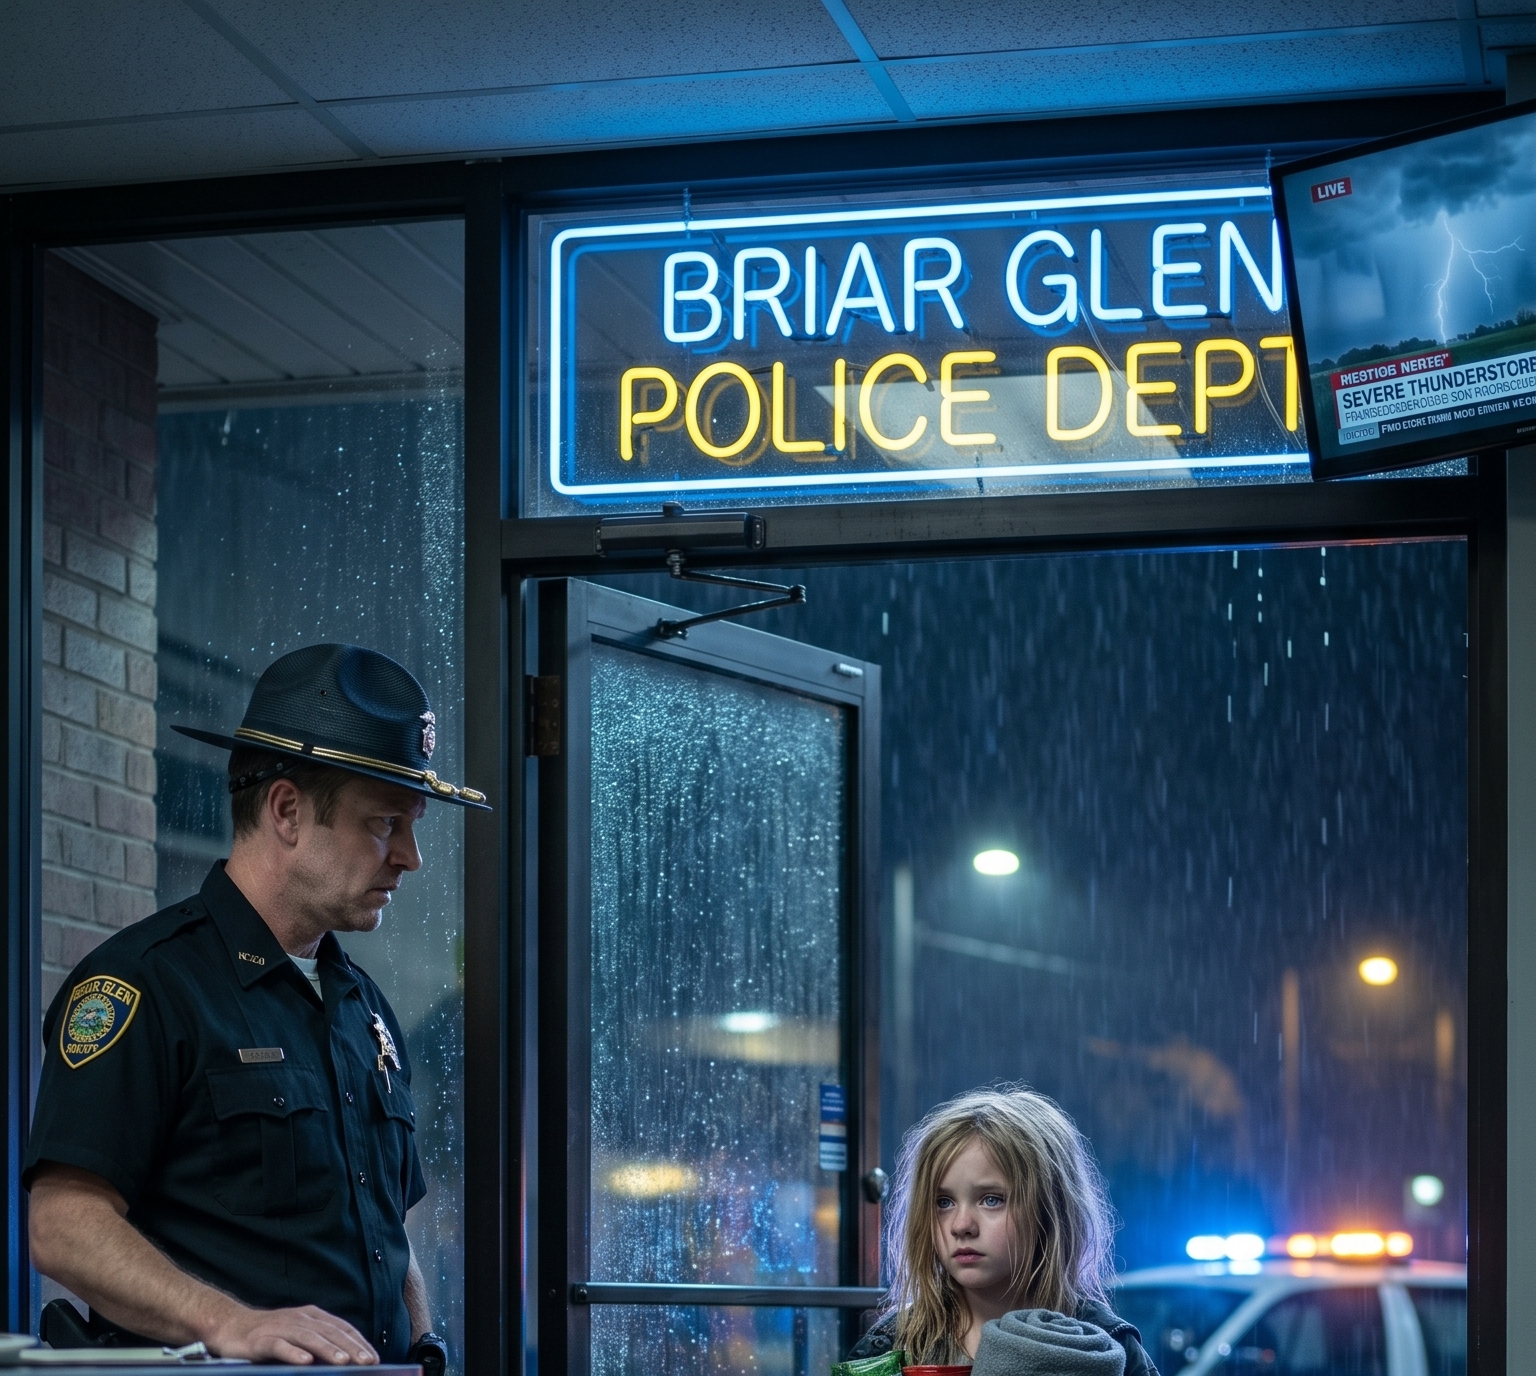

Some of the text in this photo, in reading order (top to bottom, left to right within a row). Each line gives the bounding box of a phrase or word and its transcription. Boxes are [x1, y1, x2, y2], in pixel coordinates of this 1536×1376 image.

[1317, 181, 1346, 199] LIVE
[662, 217, 1284, 344] BRIAR GLEN
[619, 335, 1299, 463] POLICE DEPT
[1342, 382, 1406, 410] SEVERE
[101, 980, 134, 1006] GLEN
